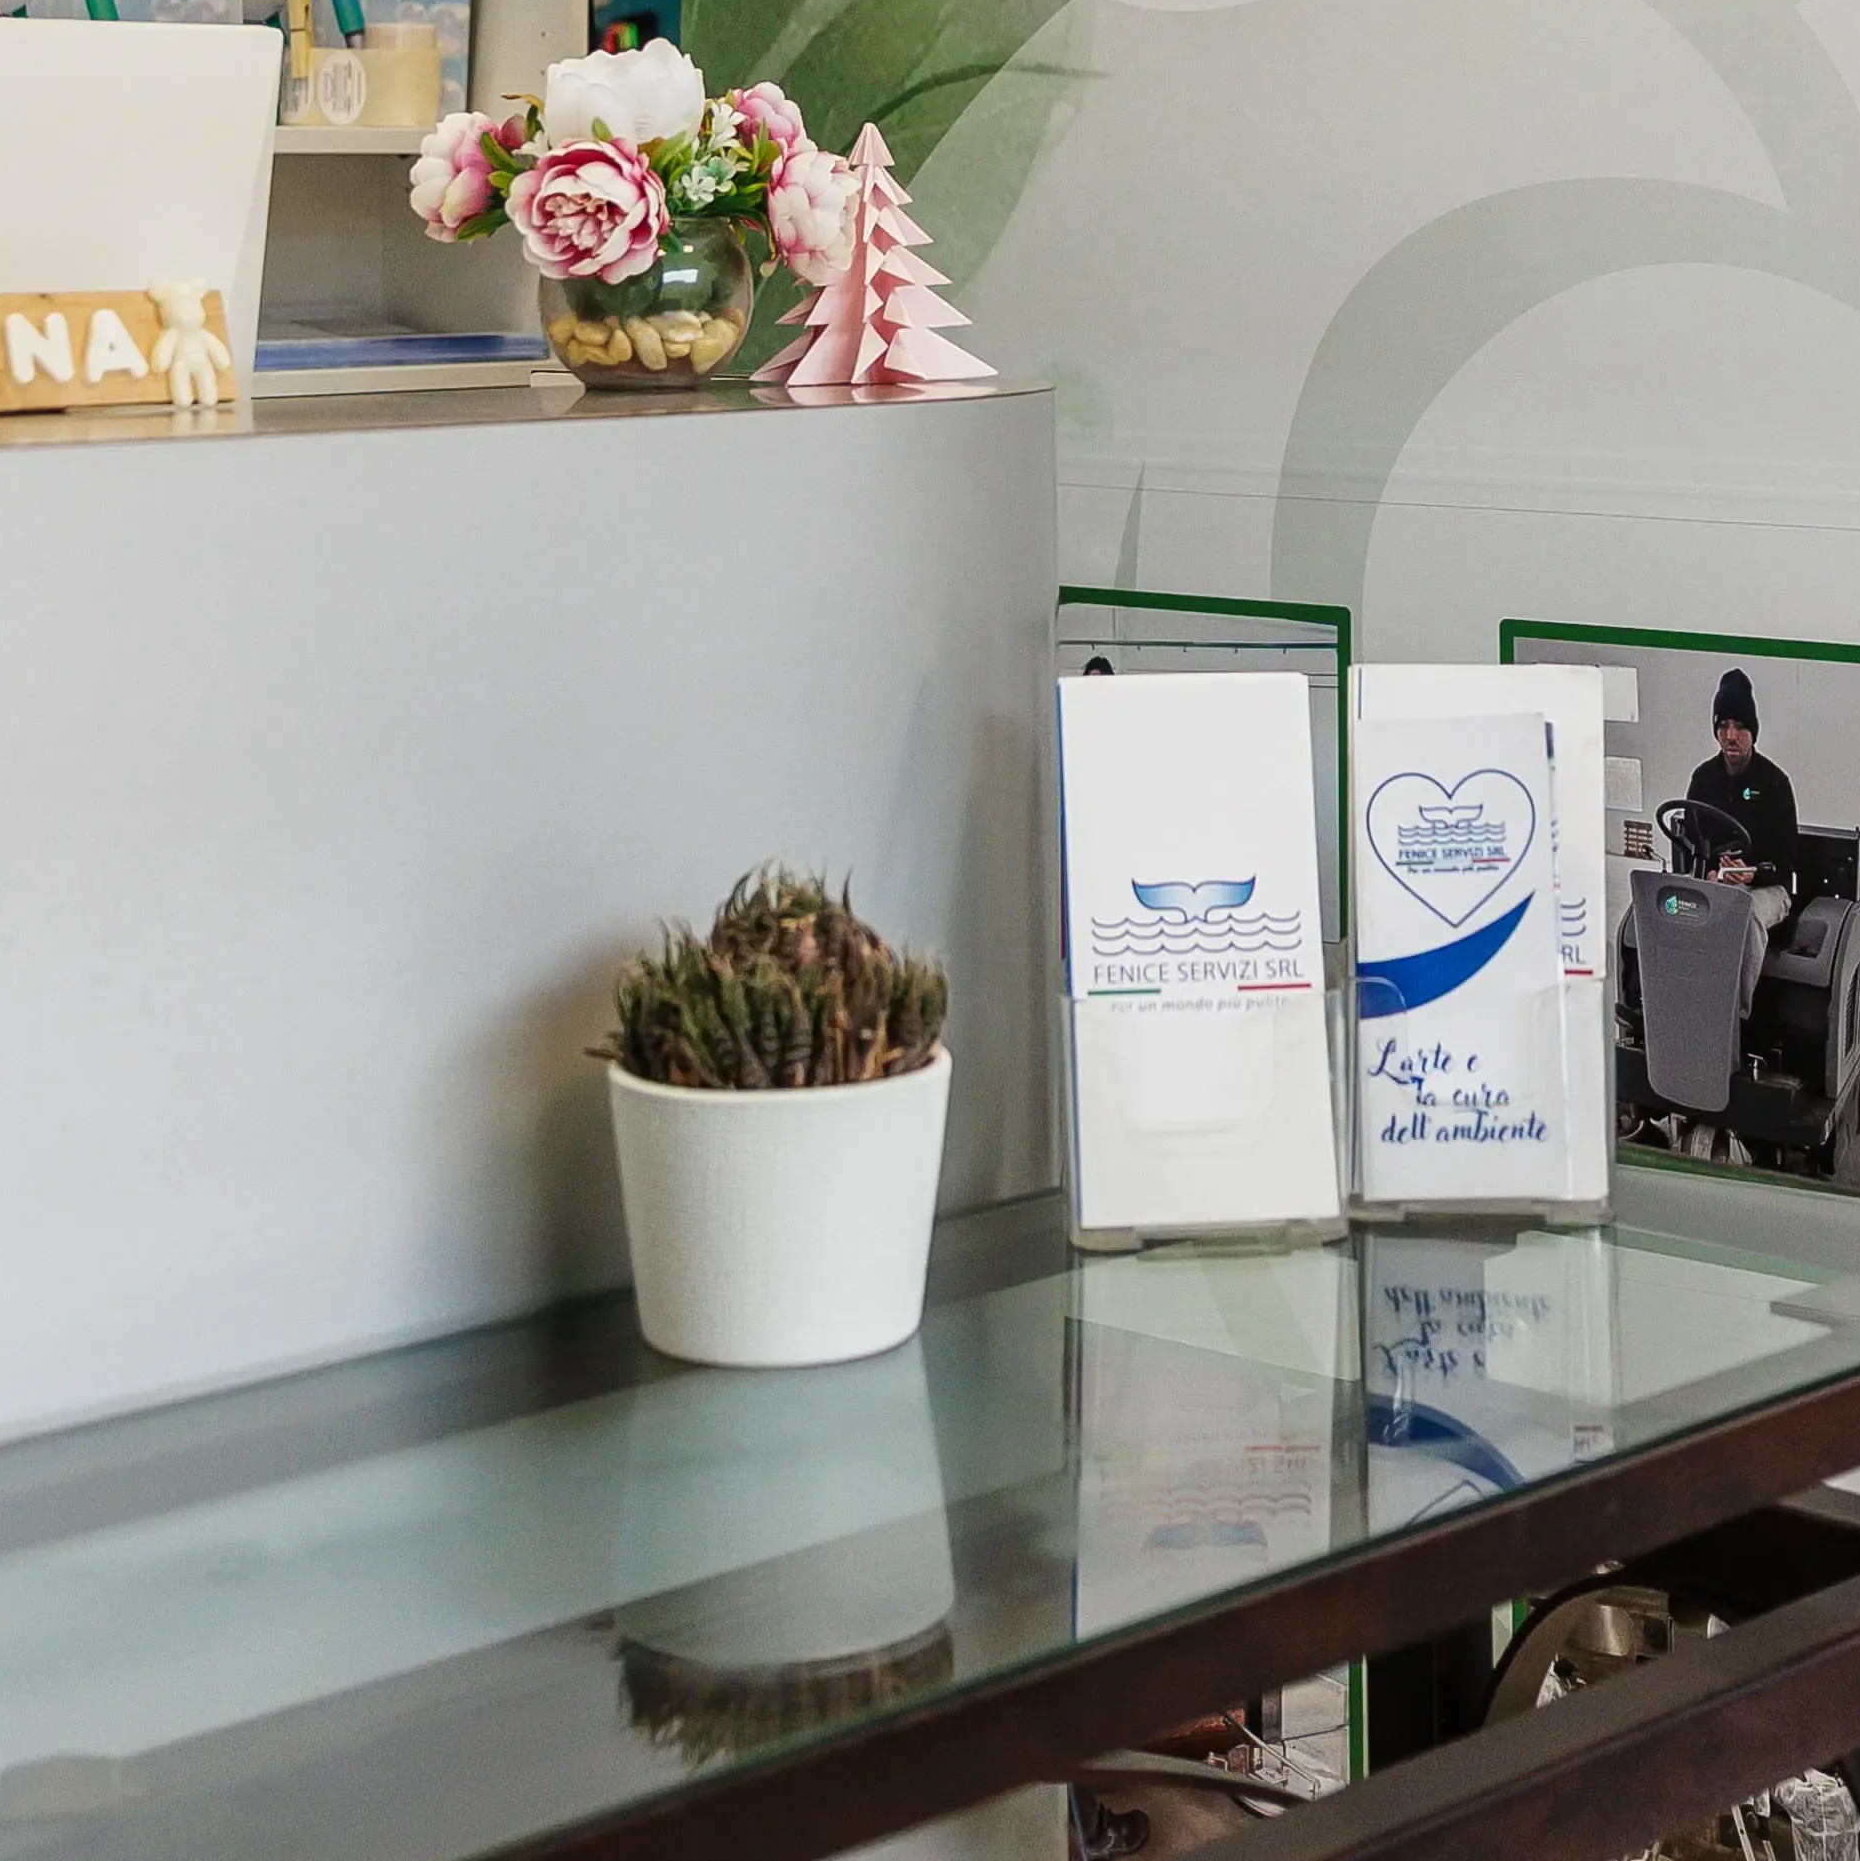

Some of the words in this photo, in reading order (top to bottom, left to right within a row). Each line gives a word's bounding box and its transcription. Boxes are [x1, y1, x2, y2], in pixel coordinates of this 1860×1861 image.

[1561, 944, 1587, 964] RL
[1093, 962, 1171, 985] FENICE
[1176, 959, 1258, 983] SERVIZI
[1265, 958, 1305, 979] SRL
[1452, 1083, 1511, 1110] cura
